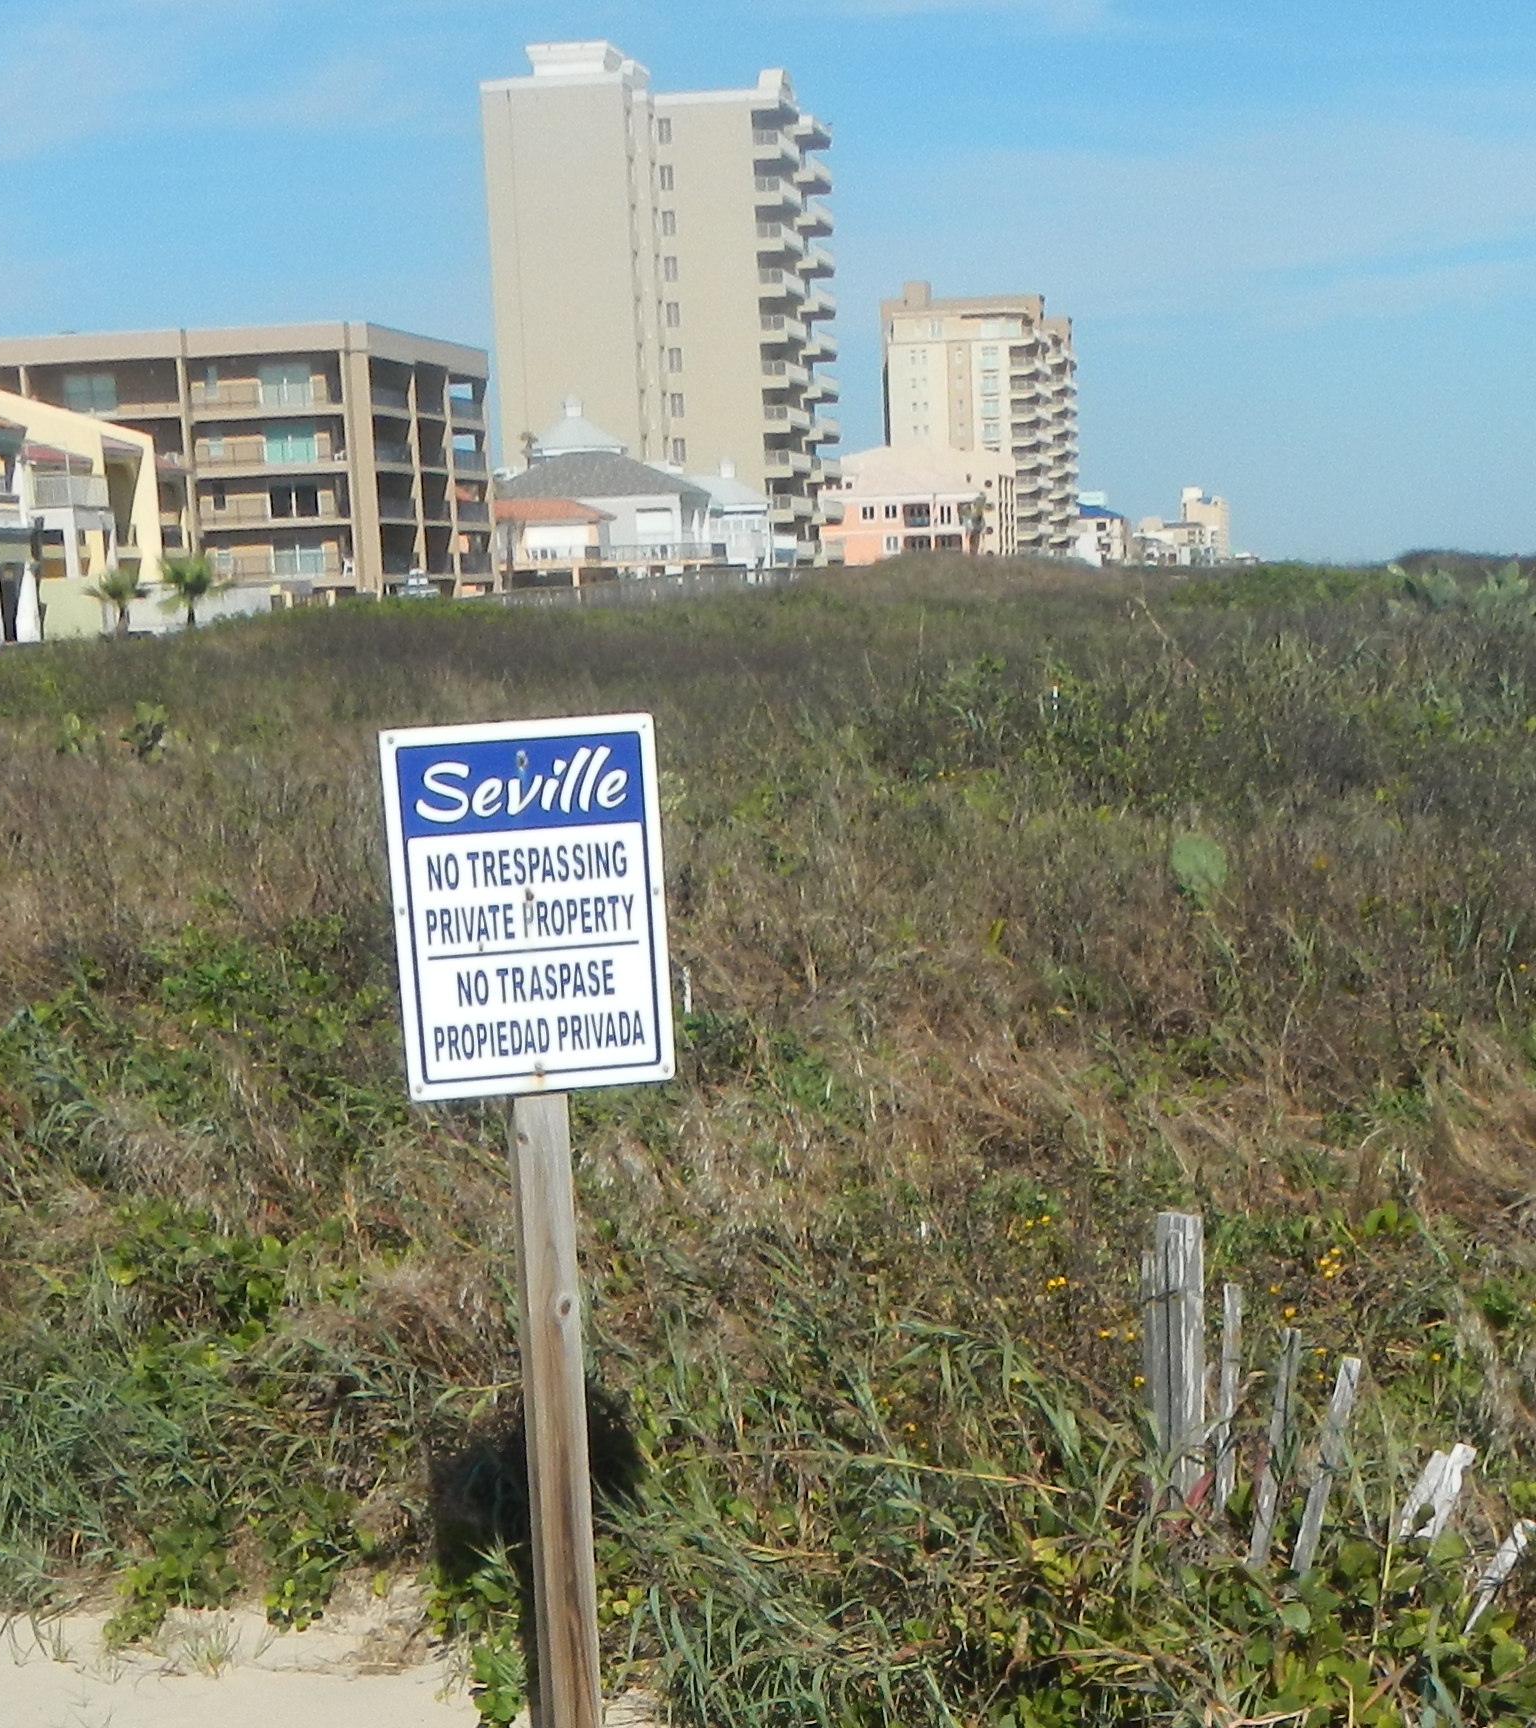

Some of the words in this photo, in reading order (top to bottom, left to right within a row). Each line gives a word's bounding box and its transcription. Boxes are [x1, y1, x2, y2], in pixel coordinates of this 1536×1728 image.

[414, 744, 629, 823] Seville
[426, 853, 460, 891] NO
[467, 840, 629, 889] TRESPASSING
[426, 903, 515, 946] PRIVATE
[522, 894, 635, 939] PROPERTY
[456, 969, 489, 1007] NO
[496, 959, 616, 1004] TRASPASE
[433, 1017, 550, 1062] PROPIEDAD
[556, 1010, 646, 1052] PRIVADA
